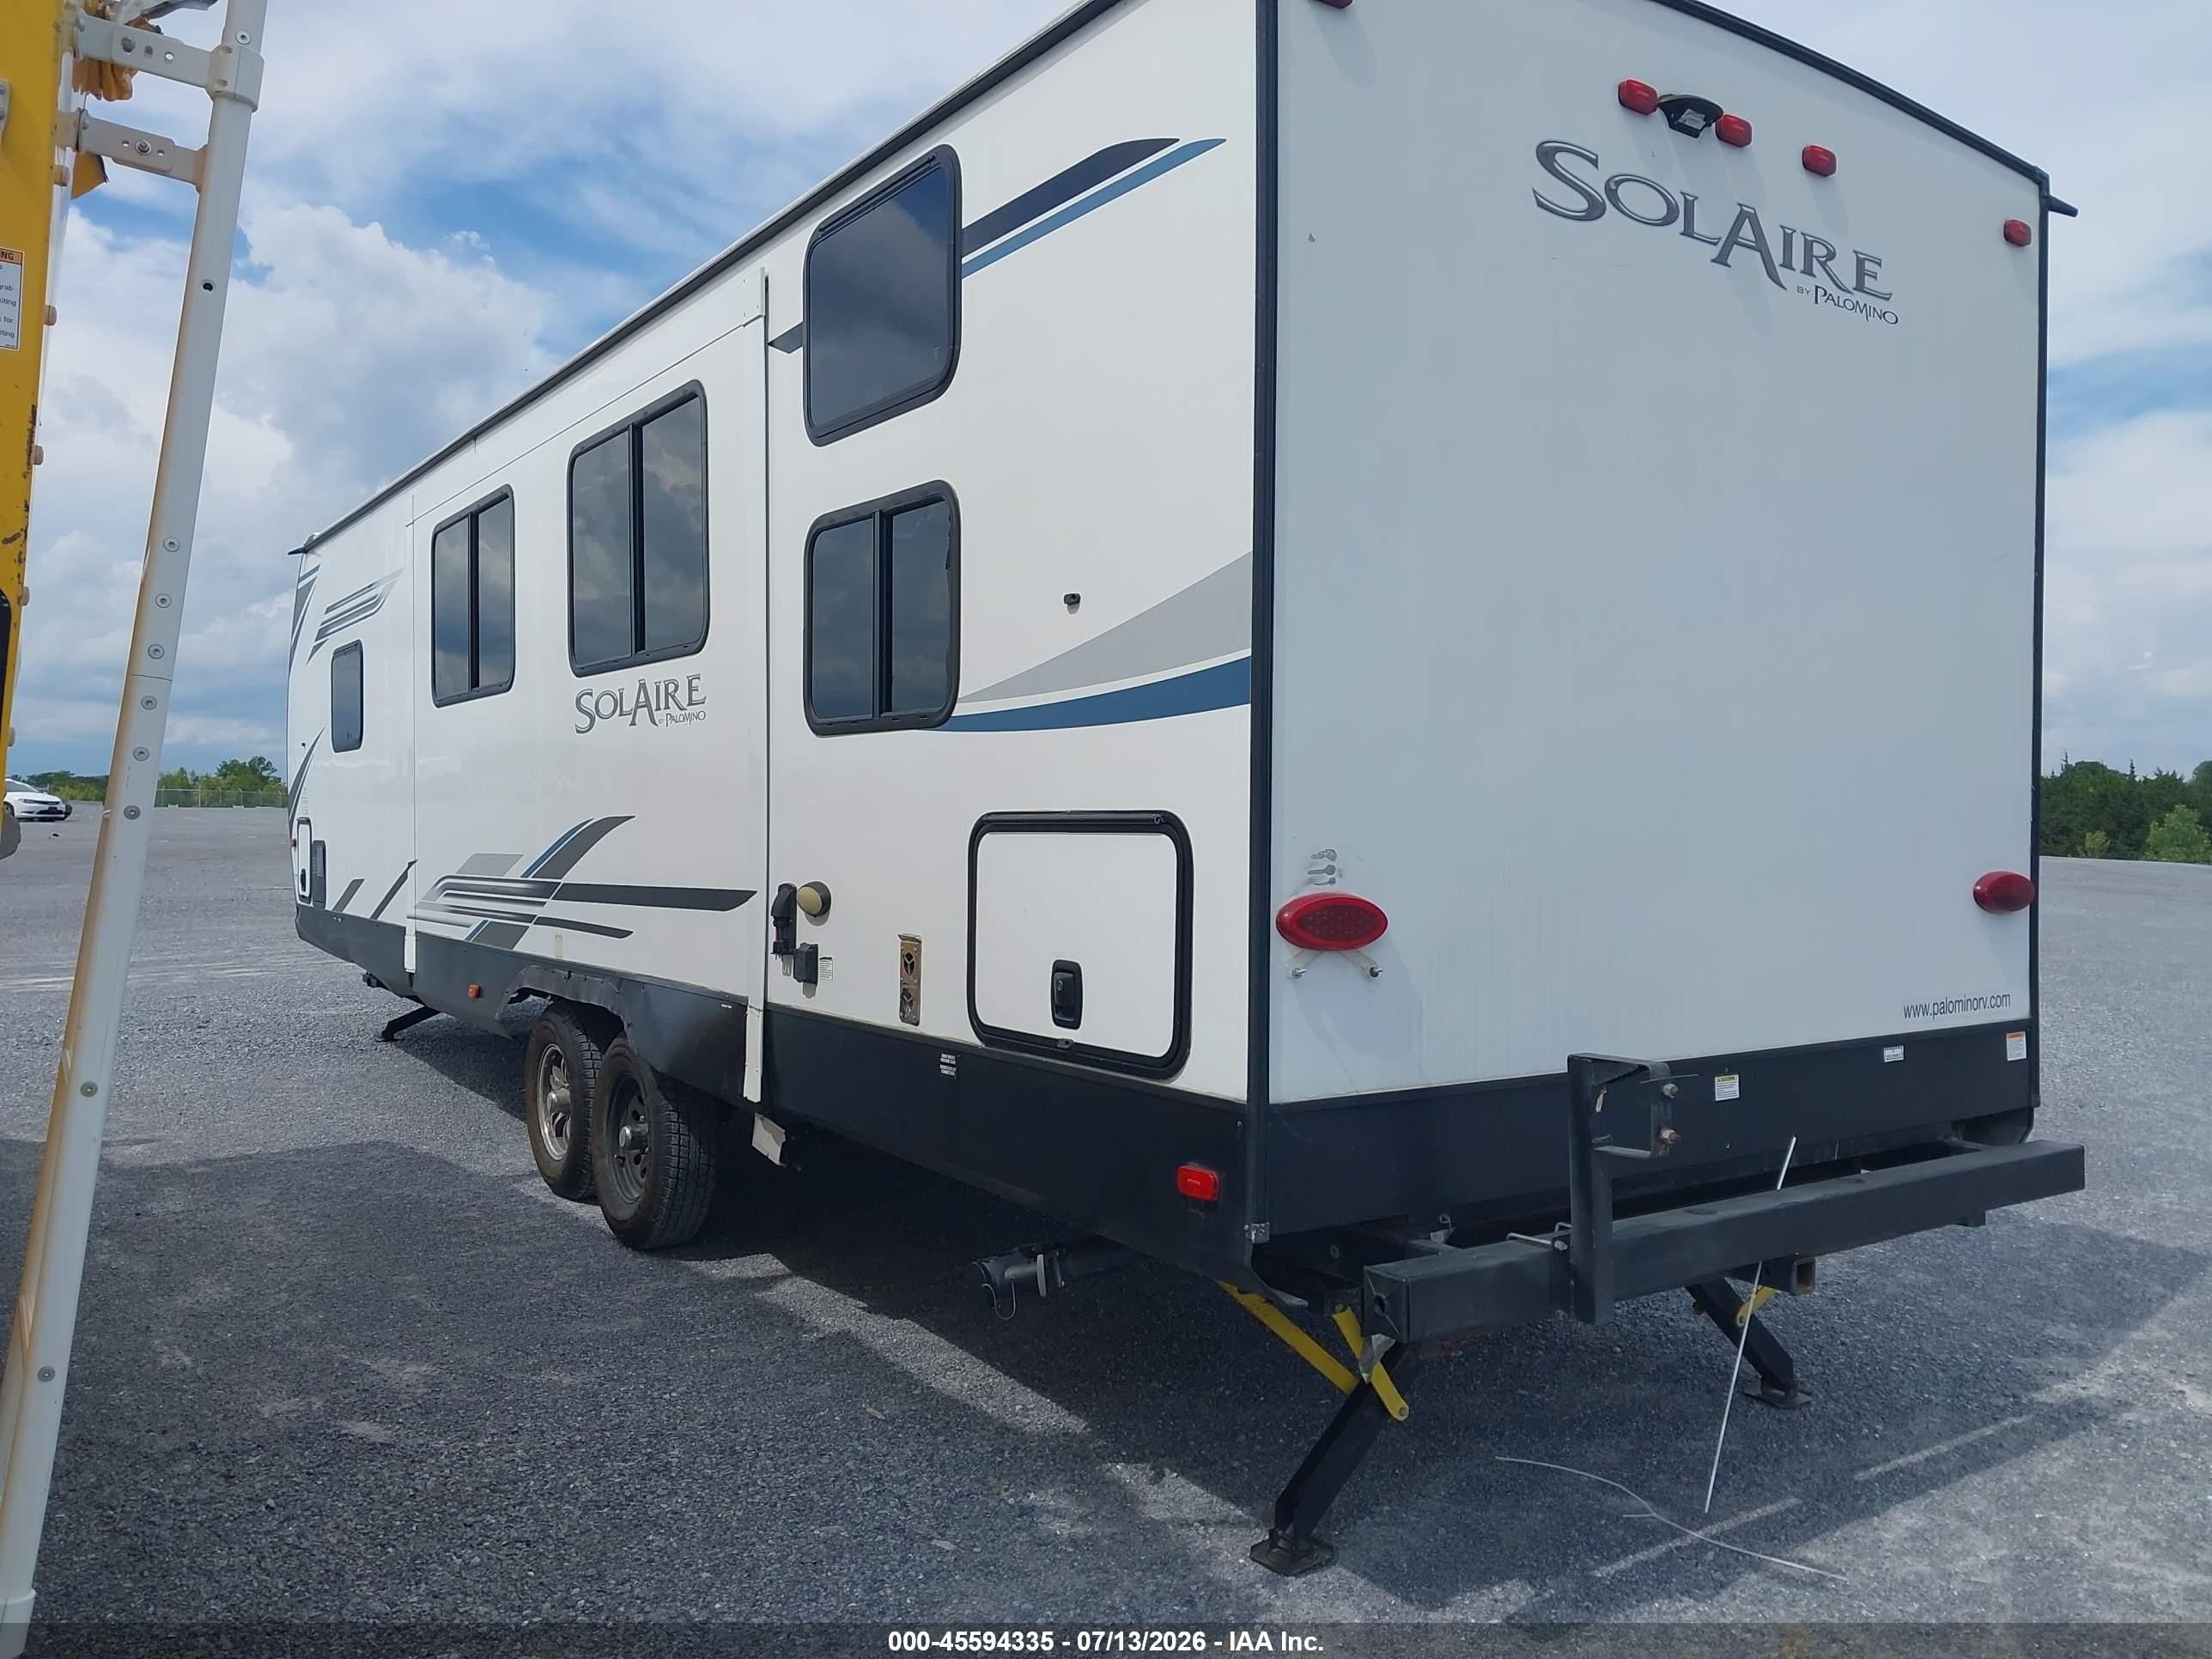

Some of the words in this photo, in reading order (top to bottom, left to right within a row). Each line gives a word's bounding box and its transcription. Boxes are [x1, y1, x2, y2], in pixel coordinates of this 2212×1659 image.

[1533, 140, 1893, 301] SOLAIRE
[1796, 285, 1811, 295] BY
[1814, 284, 1899, 325] PALOMINO
[574, 674, 707, 734] SOLAIRE
[665, 710, 707, 727] PALOMINO
[1903, 993, 2011, 1020] www.palominorv.com
